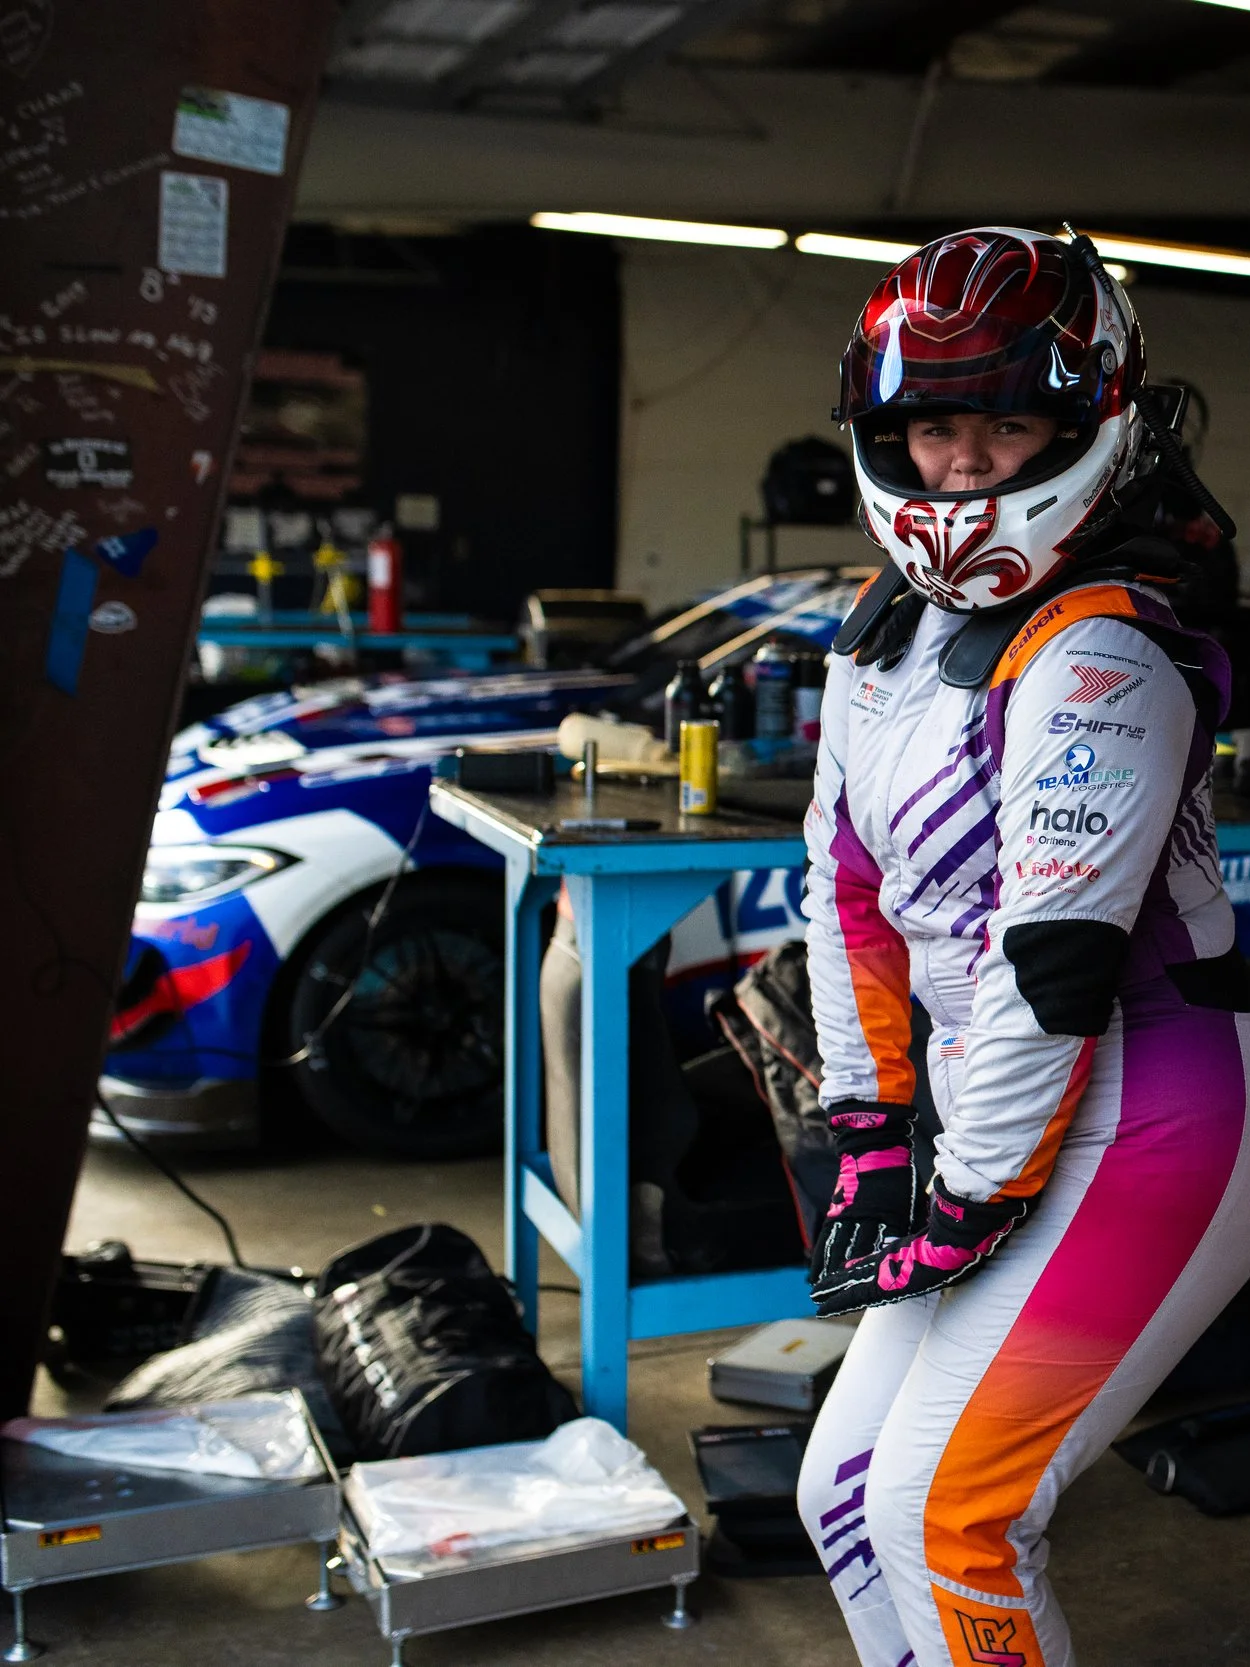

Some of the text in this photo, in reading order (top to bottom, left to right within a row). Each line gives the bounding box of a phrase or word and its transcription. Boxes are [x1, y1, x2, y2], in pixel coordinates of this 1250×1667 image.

[1008, 600, 1065, 662] Sabelt
[1104, 676, 1146, 706] YOKOHAMA
[1047, 712, 1147, 736] SHIFT UP
[1126, 733, 1145, 741] NOW
[1071, 781, 1134, 792] LOGISTICS
[1026, 835, 1037, 846] By
